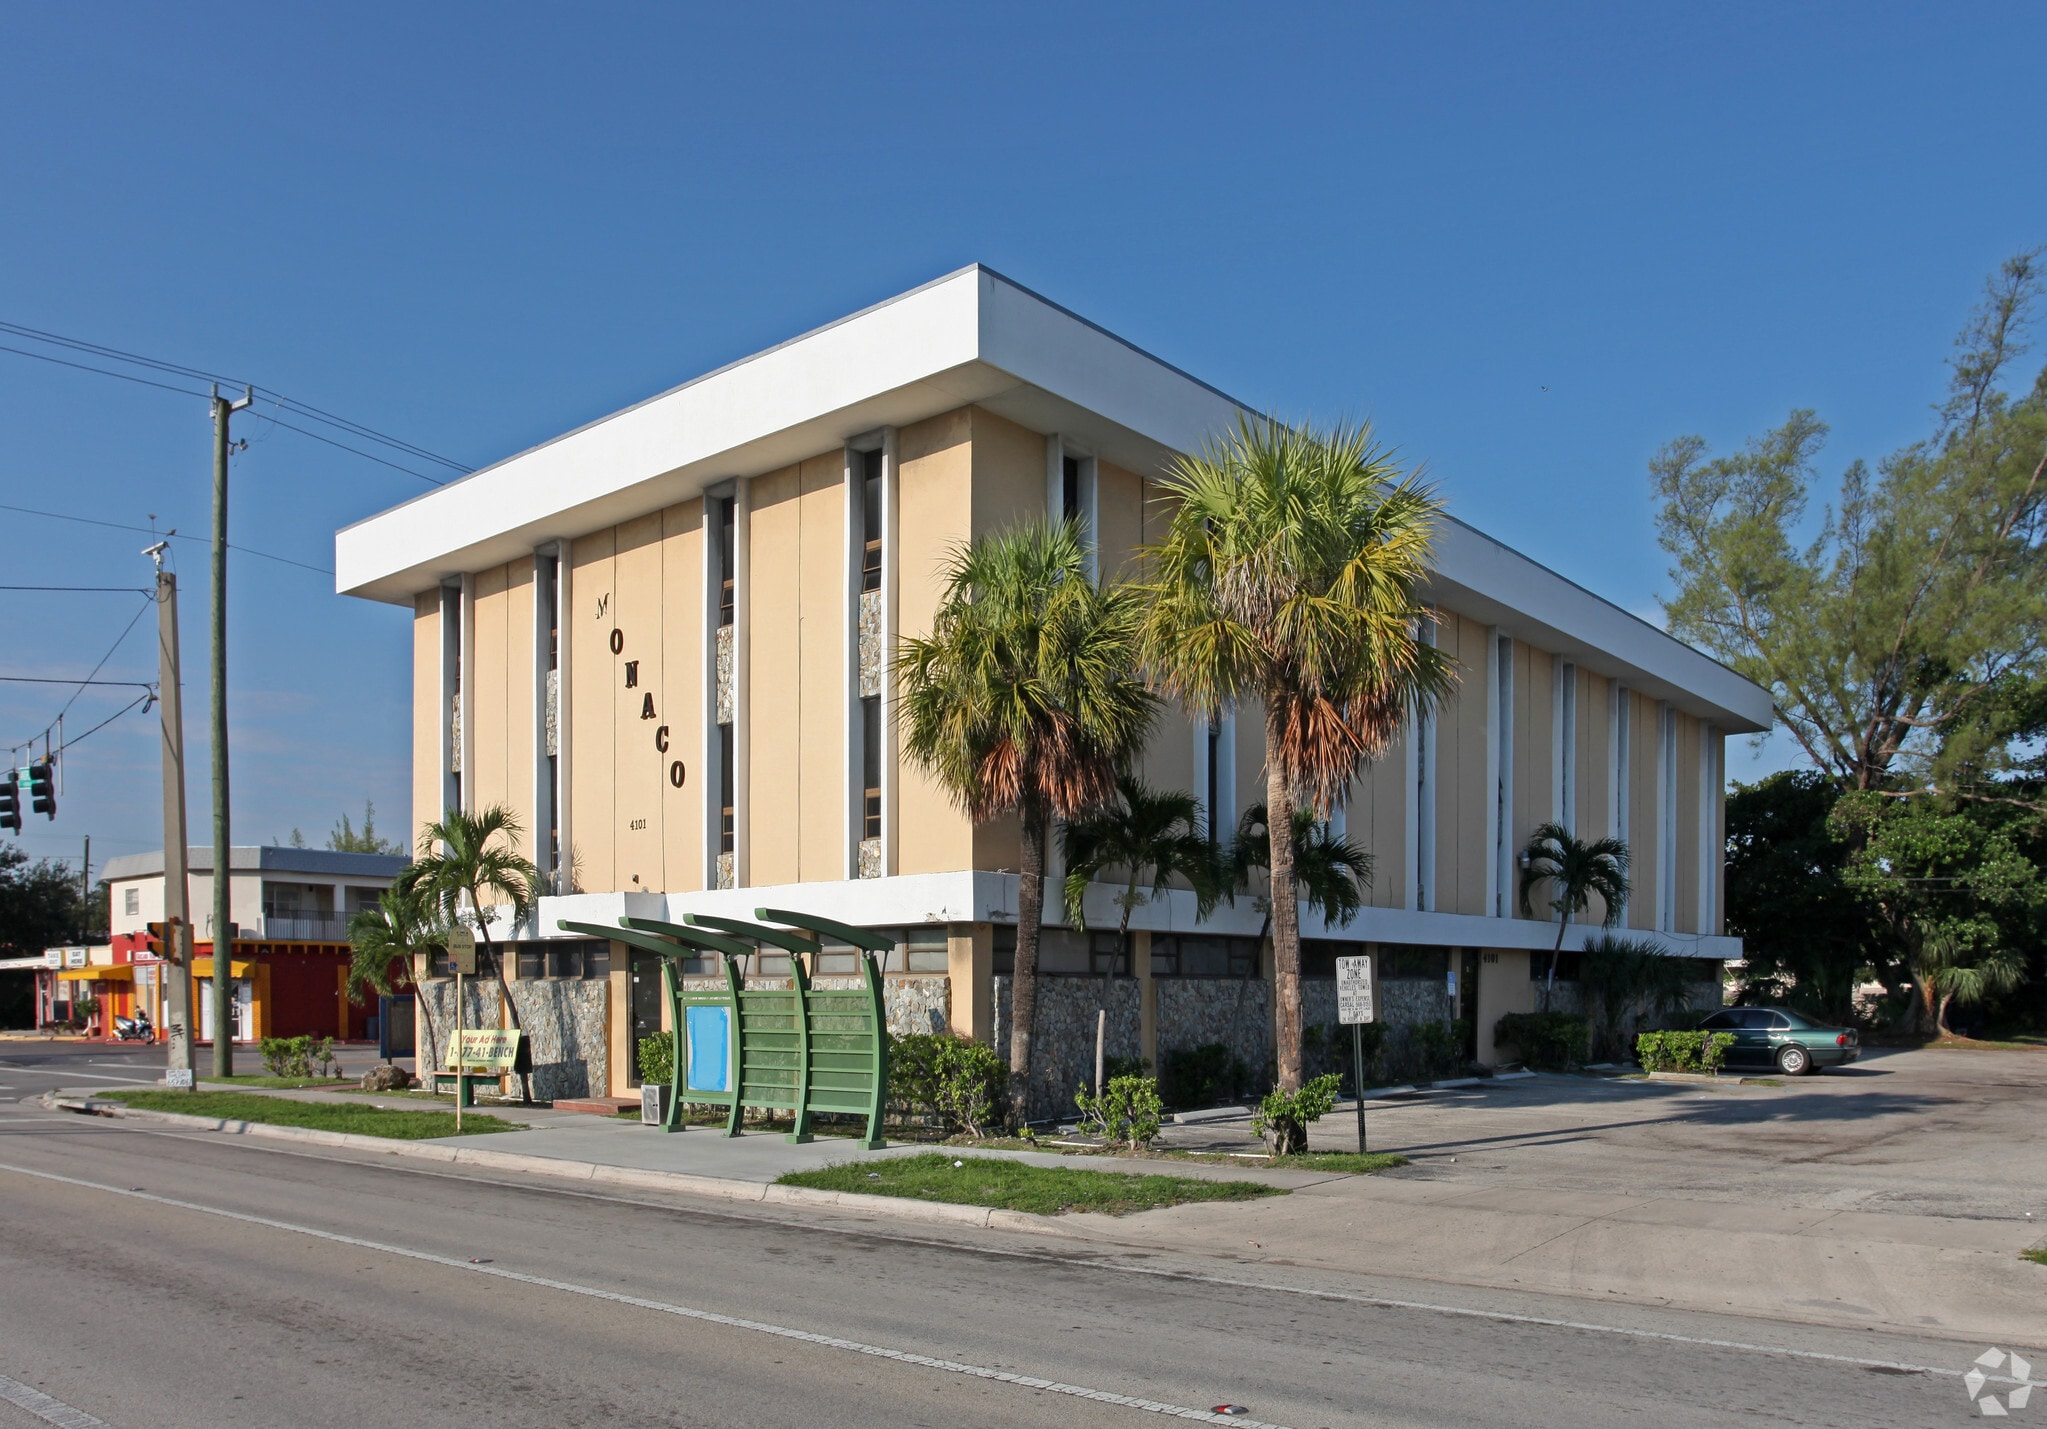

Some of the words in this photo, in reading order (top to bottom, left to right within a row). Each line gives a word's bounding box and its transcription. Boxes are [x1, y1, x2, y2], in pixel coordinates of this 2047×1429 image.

[596, 592, 686, 789] MONACO
[630, 818, 647, 831] 4101
[1347, 968, 1361, 979] ZONE
[462, 1034, 478, 1043] Your
[479, 1034, 490, 1043] Ad
[491, 1035, 507, 1043] Here
[450, 1046, 514, 1058] 1-77-41-BENCH
